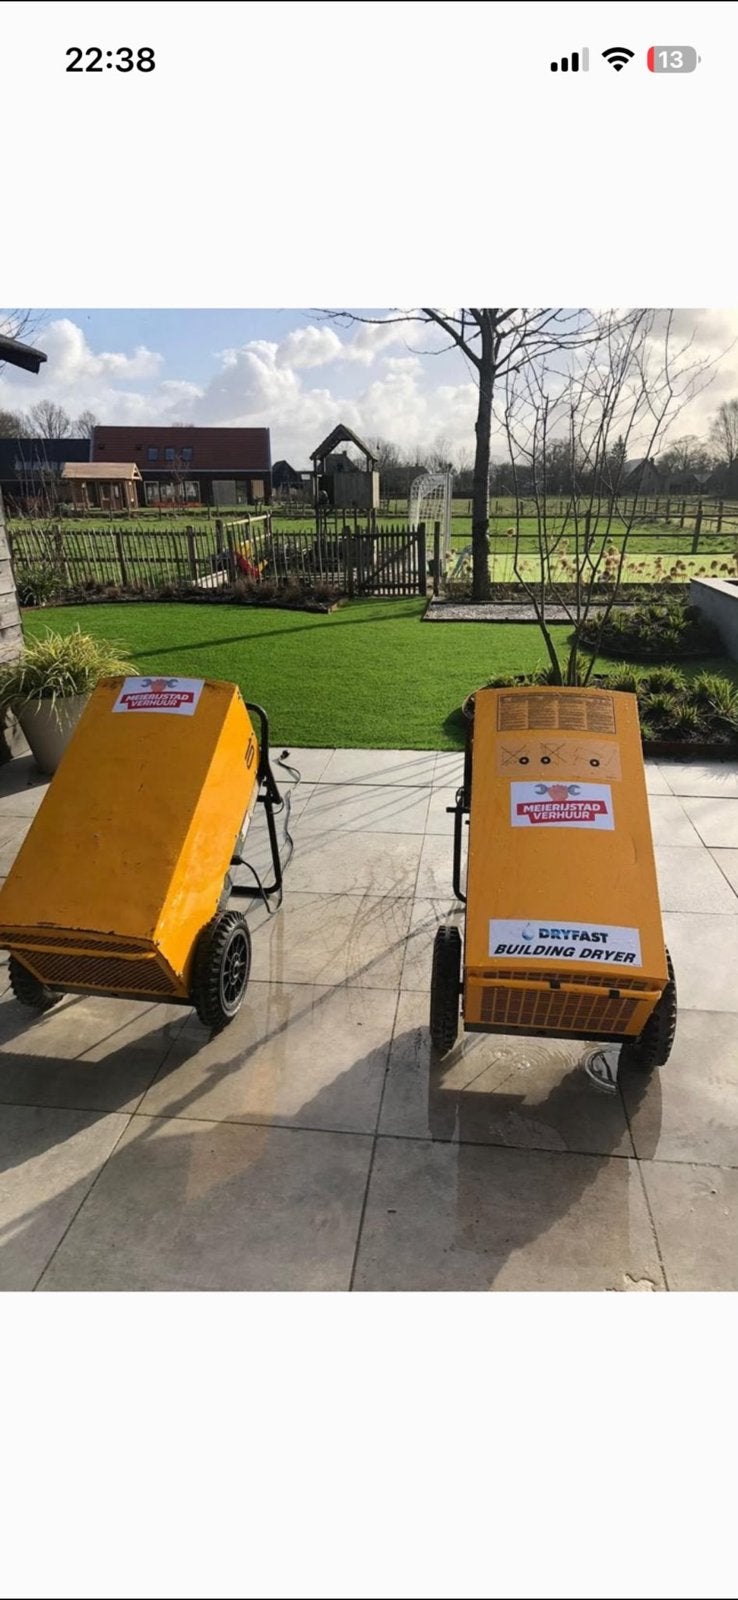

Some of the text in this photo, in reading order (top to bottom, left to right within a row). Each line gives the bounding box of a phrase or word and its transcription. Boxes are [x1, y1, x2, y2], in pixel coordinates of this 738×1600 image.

[126, 693, 189, 702] MEIERIJSTAD
[131, 699, 177, 707] VERHUUR
[523, 803, 601, 813] MEIERIJSTAD
[533, 811, 590, 820] VERHUUR
[538, 928, 609, 943] DRYFAST
[494, 943, 636, 963] BUILDING DRYER
